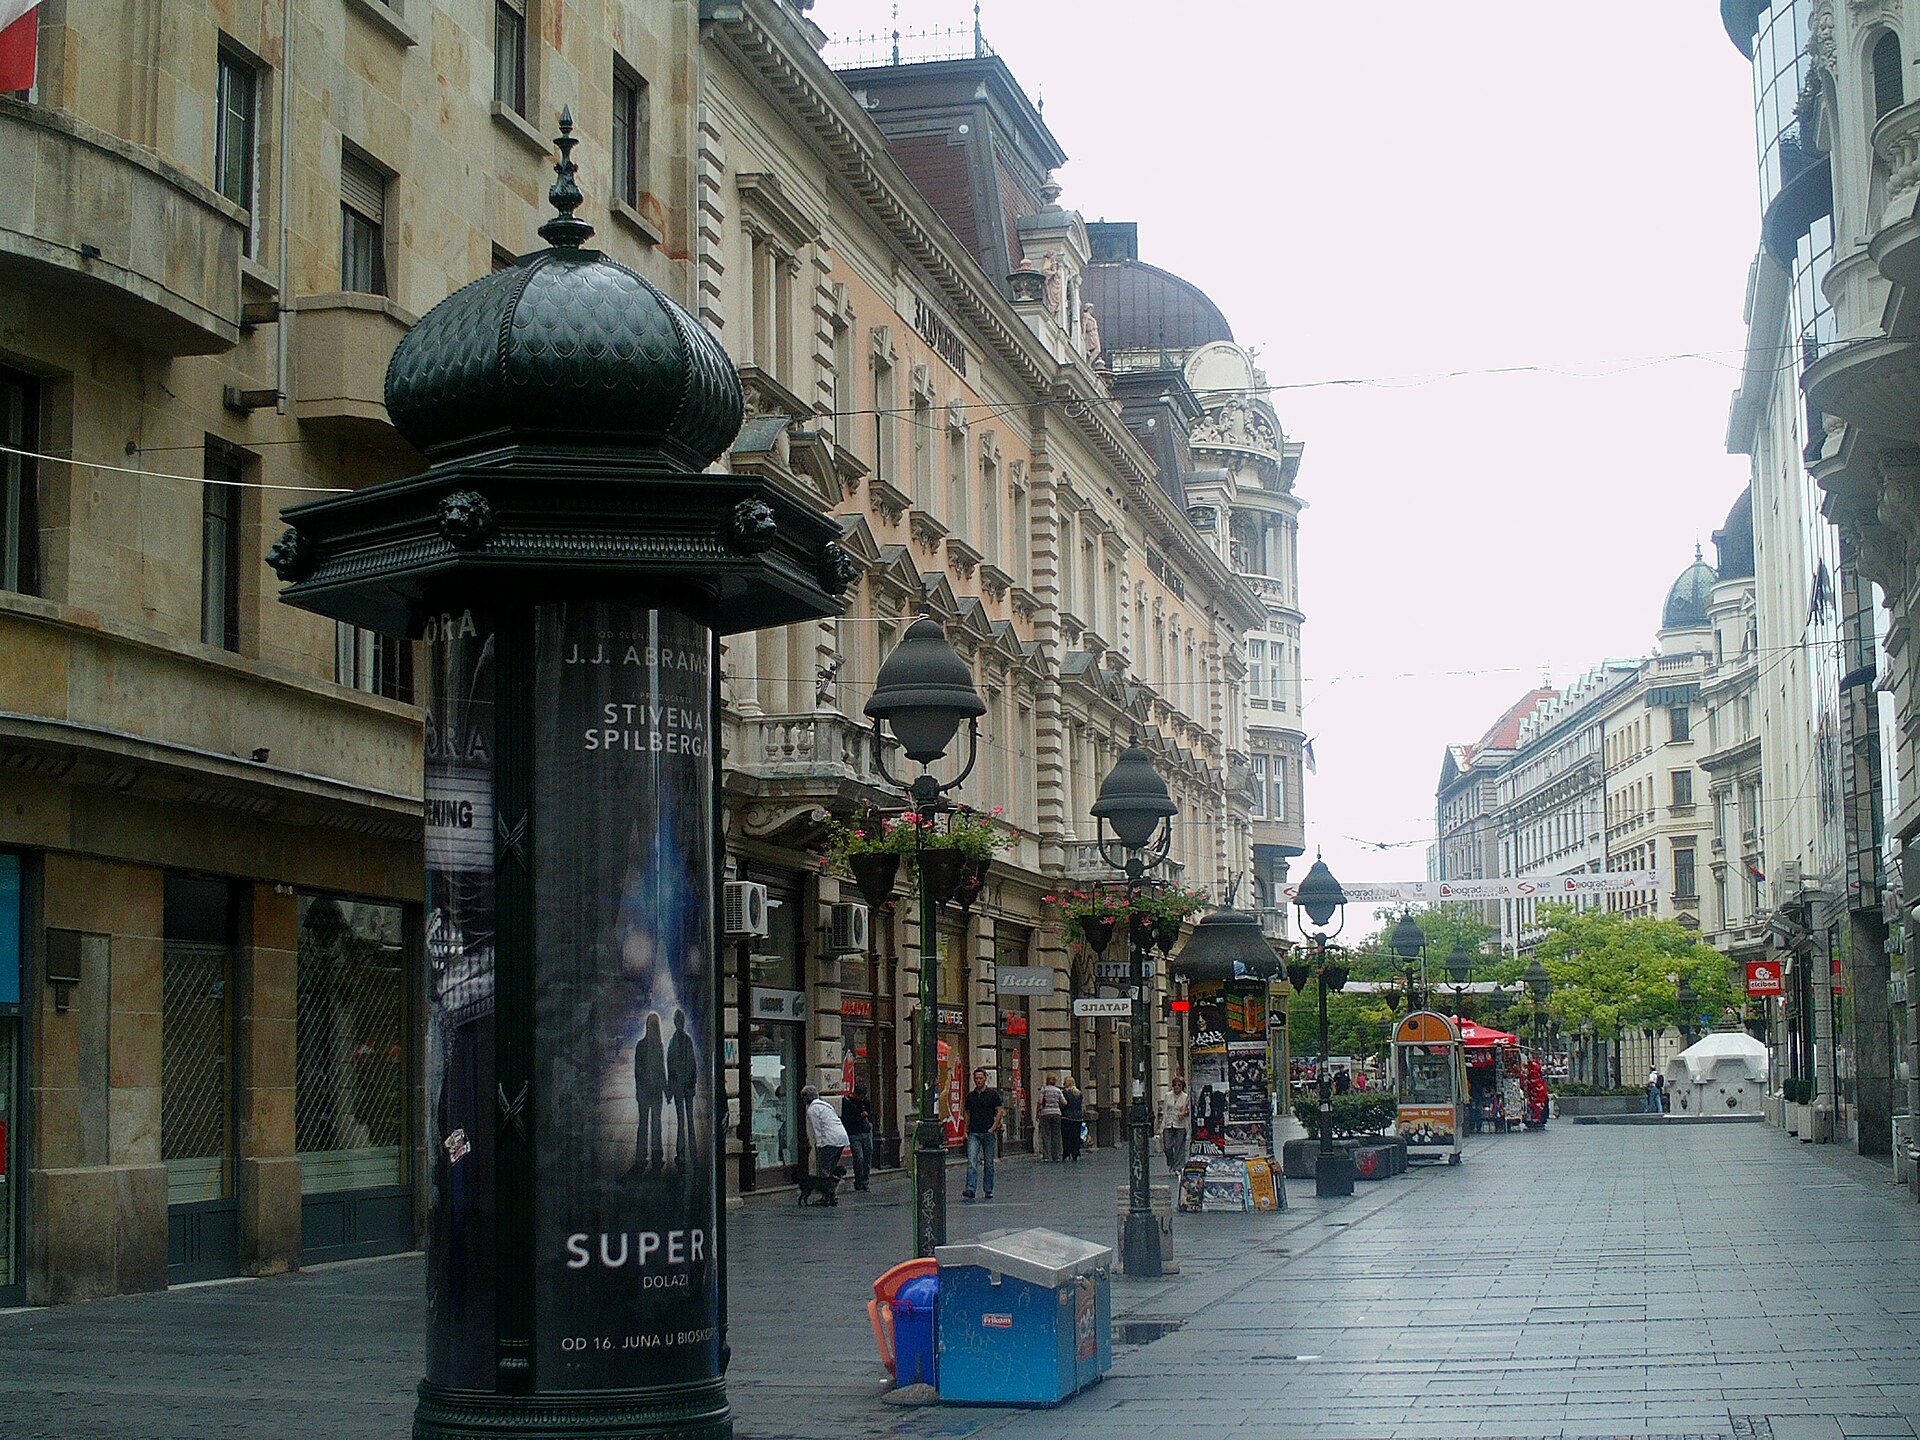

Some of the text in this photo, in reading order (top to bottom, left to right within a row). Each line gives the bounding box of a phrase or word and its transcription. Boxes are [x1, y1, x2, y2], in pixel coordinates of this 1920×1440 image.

[565, 643, 709, 677] J.J. ABRAMS
[604, 702, 704, 732] STIVENA
[584, 728, 709, 759] SPILBERGA
[1096, 964, 1151, 977] OPTIR
[1001, 974, 1048, 988] Bata
[1081, 1003, 1129, 1012] ЗЛАТАР
[566, 1228, 705, 1269] SUPER
[643, 1274, 689, 1289] DOLAZI
[561, 1338, 587, 1350] OD
[593, 1337, 616, 1350] 16.
[622, 1334, 661, 1350] JUNA
[665, 1333, 674, 1345] U
